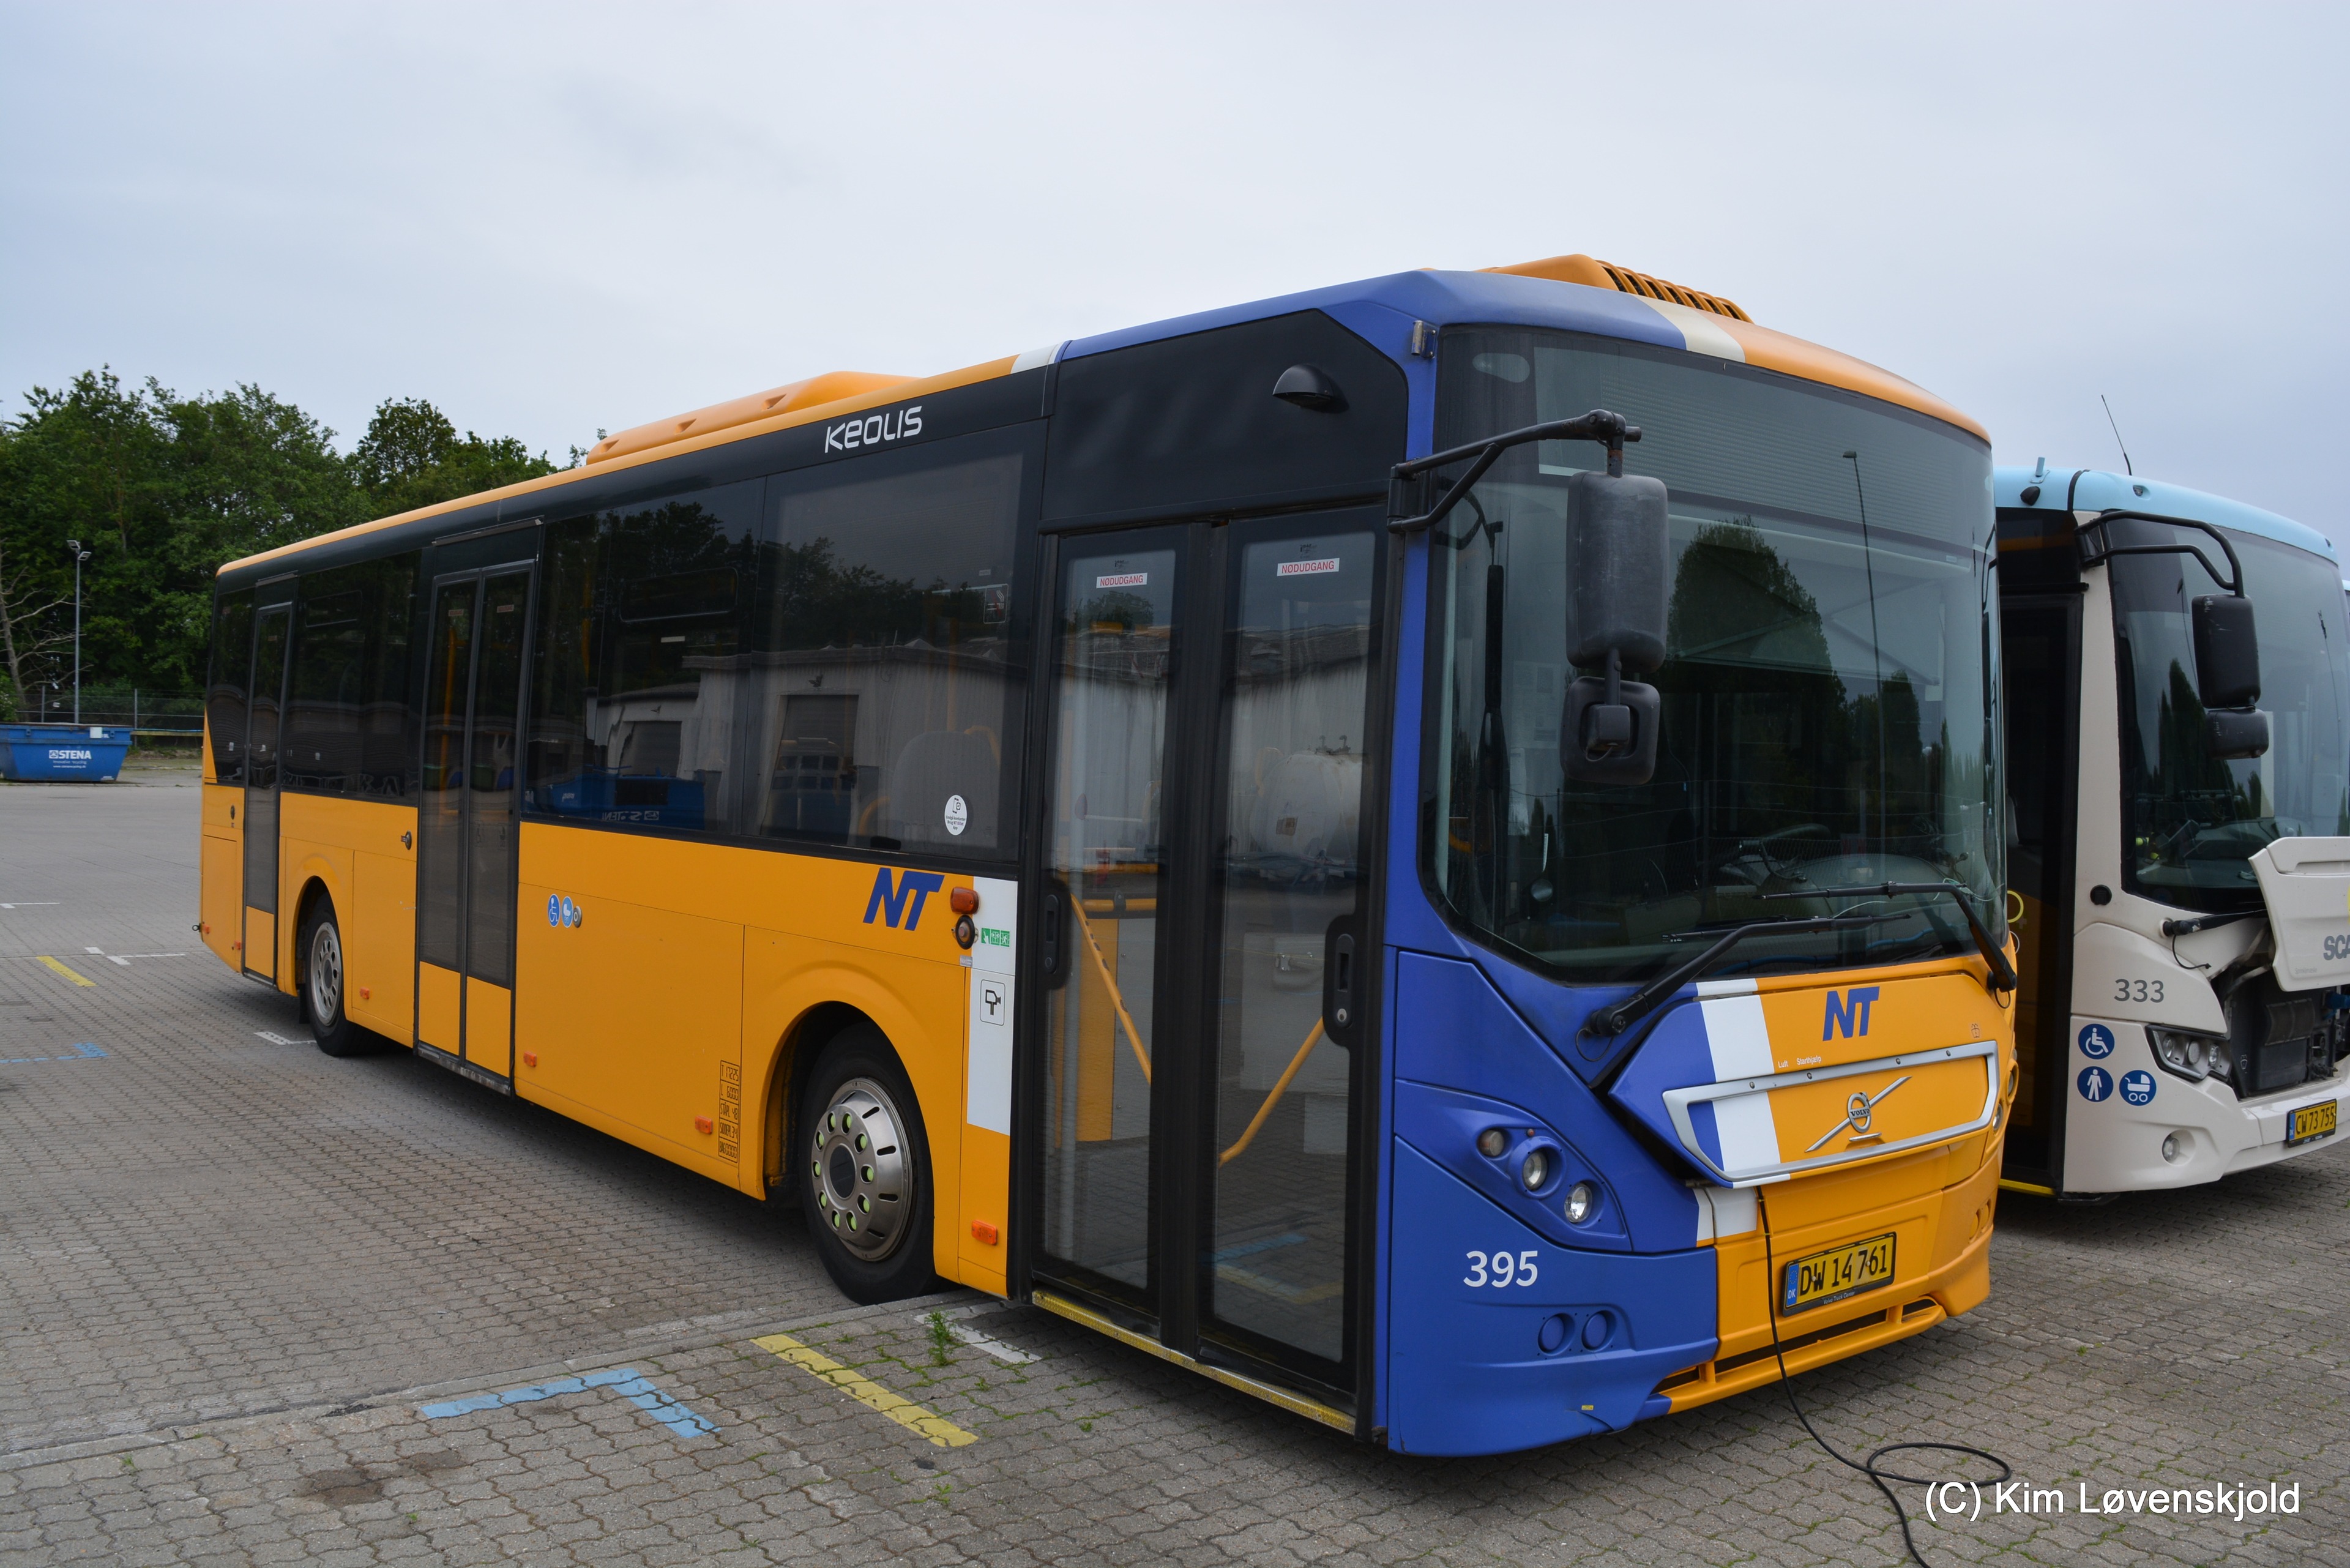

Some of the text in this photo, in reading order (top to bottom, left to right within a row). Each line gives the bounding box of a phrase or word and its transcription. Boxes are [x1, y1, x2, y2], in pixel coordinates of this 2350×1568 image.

[1281, 561, 1335, 573] NØDUDGANG
[1100, 575, 1144, 586] NØDUDGANG
[58, 750, 92, 760] STENA
[863, 867, 945, 931] NT
[2113, 979, 2165, 1003] 333
[1822, 986, 1880, 1041] NT
[1796, 1055, 1822, 1066] Starthjælp
[1850, 1108, 1870, 1117] VOLVO
[2296, 1105, 2335, 1135] CW 73 755
[1463, 1250, 1539, 1288] 395
[1799, 1244, 1887, 1296] DW 14 761
[1788, 1288, 1796, 1299] DK
